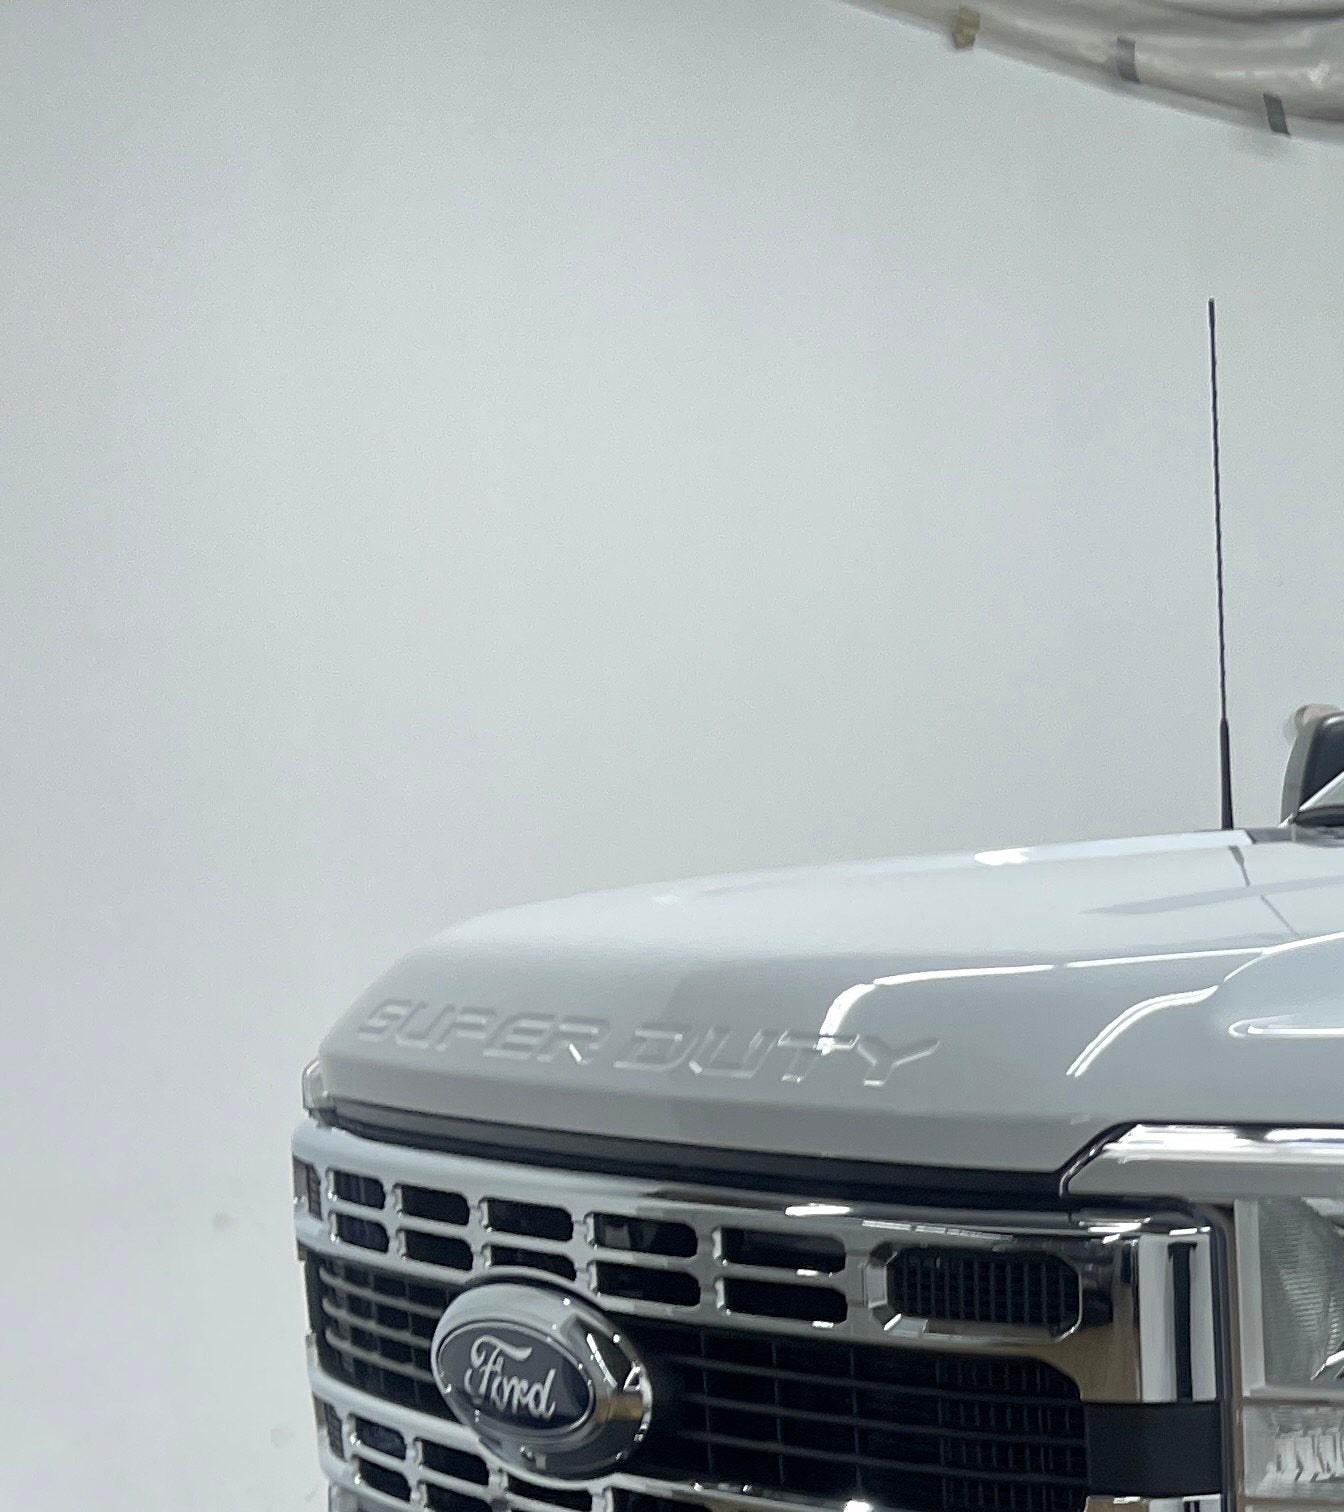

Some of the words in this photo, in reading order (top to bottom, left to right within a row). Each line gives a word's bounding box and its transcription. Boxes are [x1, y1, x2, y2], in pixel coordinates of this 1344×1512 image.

[357, 998, 611, 1064] SUPER
[614, 1021, 942, 1087] DUTY
[463, 1334, 557, 1420] Ford
